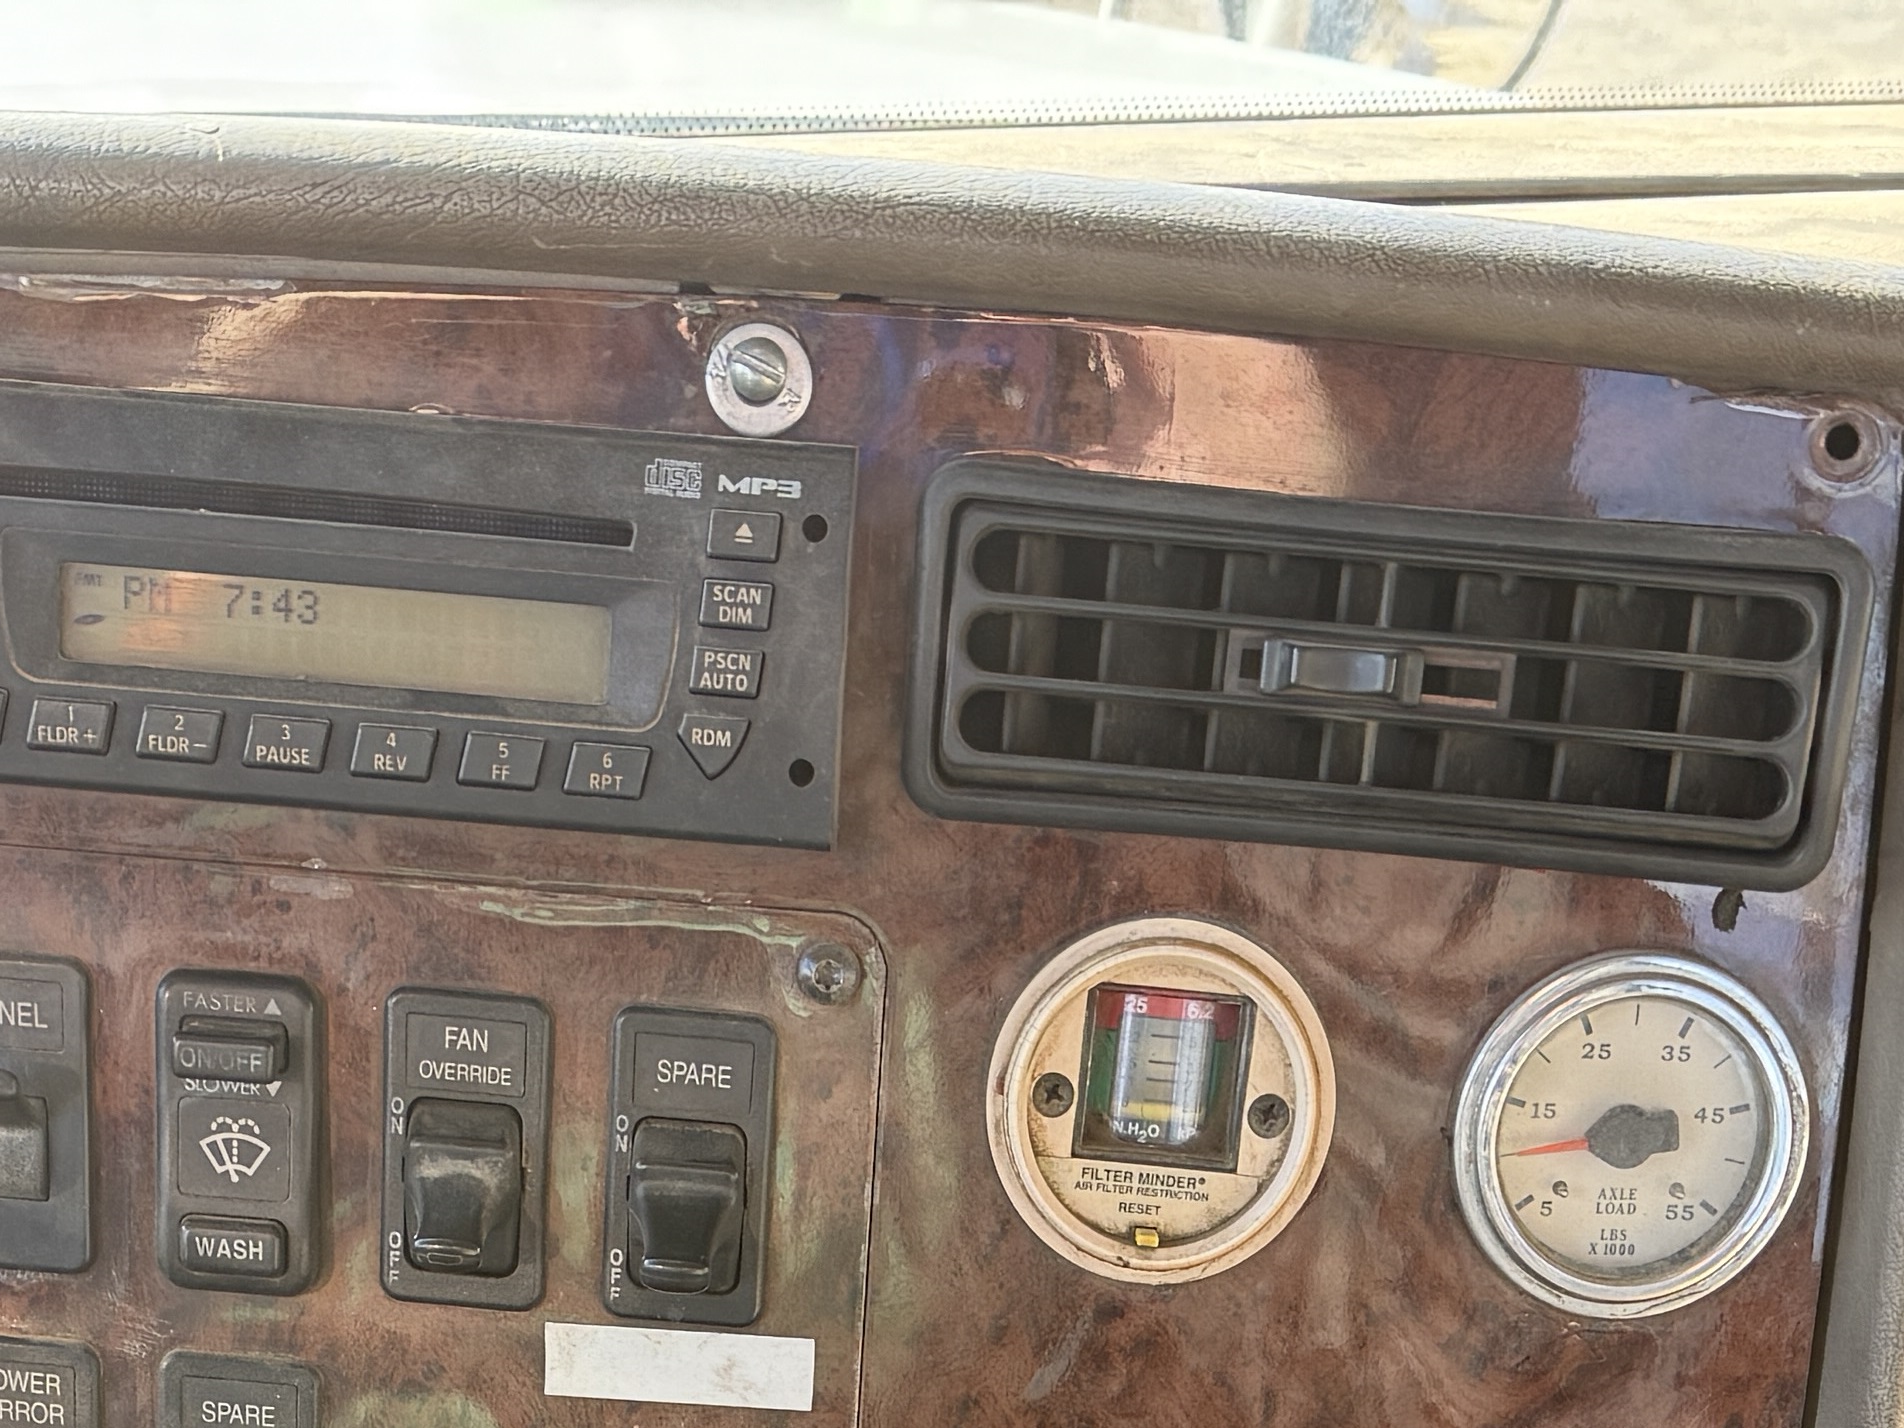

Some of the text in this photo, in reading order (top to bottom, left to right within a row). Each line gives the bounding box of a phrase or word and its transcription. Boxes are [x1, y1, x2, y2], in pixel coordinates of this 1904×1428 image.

[717, 474, 802, 499] MP3
[222, 583, 319, 625] 7:43
[713, 585, 761, 605] SCAN
[719, 606, 752, 624] DIM
[704, 651, 751, 671] PSCN
[699, 672, 748, 691] AUTO
[67, 706, 74, 722] 1
[174, 715, 184, 731] 2
[281, 724, 291, 740] 3
[386, 732, 397, 747] 4
[691, 728, 731, 747] RDM
[256, 745, 310, 765] PAUSE
[498, 742, 508, 759] 5
[373, 754, 407, 772] REV
[603, 752, 612, 768] 6
[492, 763, 511, 781] FF
[589, 773, 623, 791] RPT
[182, 990, 257, 1015] FASTER
[444, 1026, 489, 1054] FAN
[179, 1046, 263, 1075] ON/OFF
[1581, 1043, 1611, 1061] 25
[1661, 1044, 1692, 1063] 35
[418, 1060, 513, 1088] OVERRIDE
[656, 1060, 732, 1089] SPARE
[1530, 1102, 1557, 1120] 15
[1694, 1106, 1725, 1124] 45
[1081, 1167, 1134, 1185] FILTER
[1598, 1186, 1637, 1201] AXLE
[1118, 1201, 1162, 1216] RESET
[1539, 1201, 1553, 1217] 5
[1596, 1202, 1636, 1216] LOAD
[1665, 1203, 1695, 1221] 55
[1600, 1228, 1627, 1242] LBS
[195, 1235, 264, 1262] WASH
[1588, 1243, 1636, 1256] X 1000
[201, 1400, 276, 1428] SPARE
